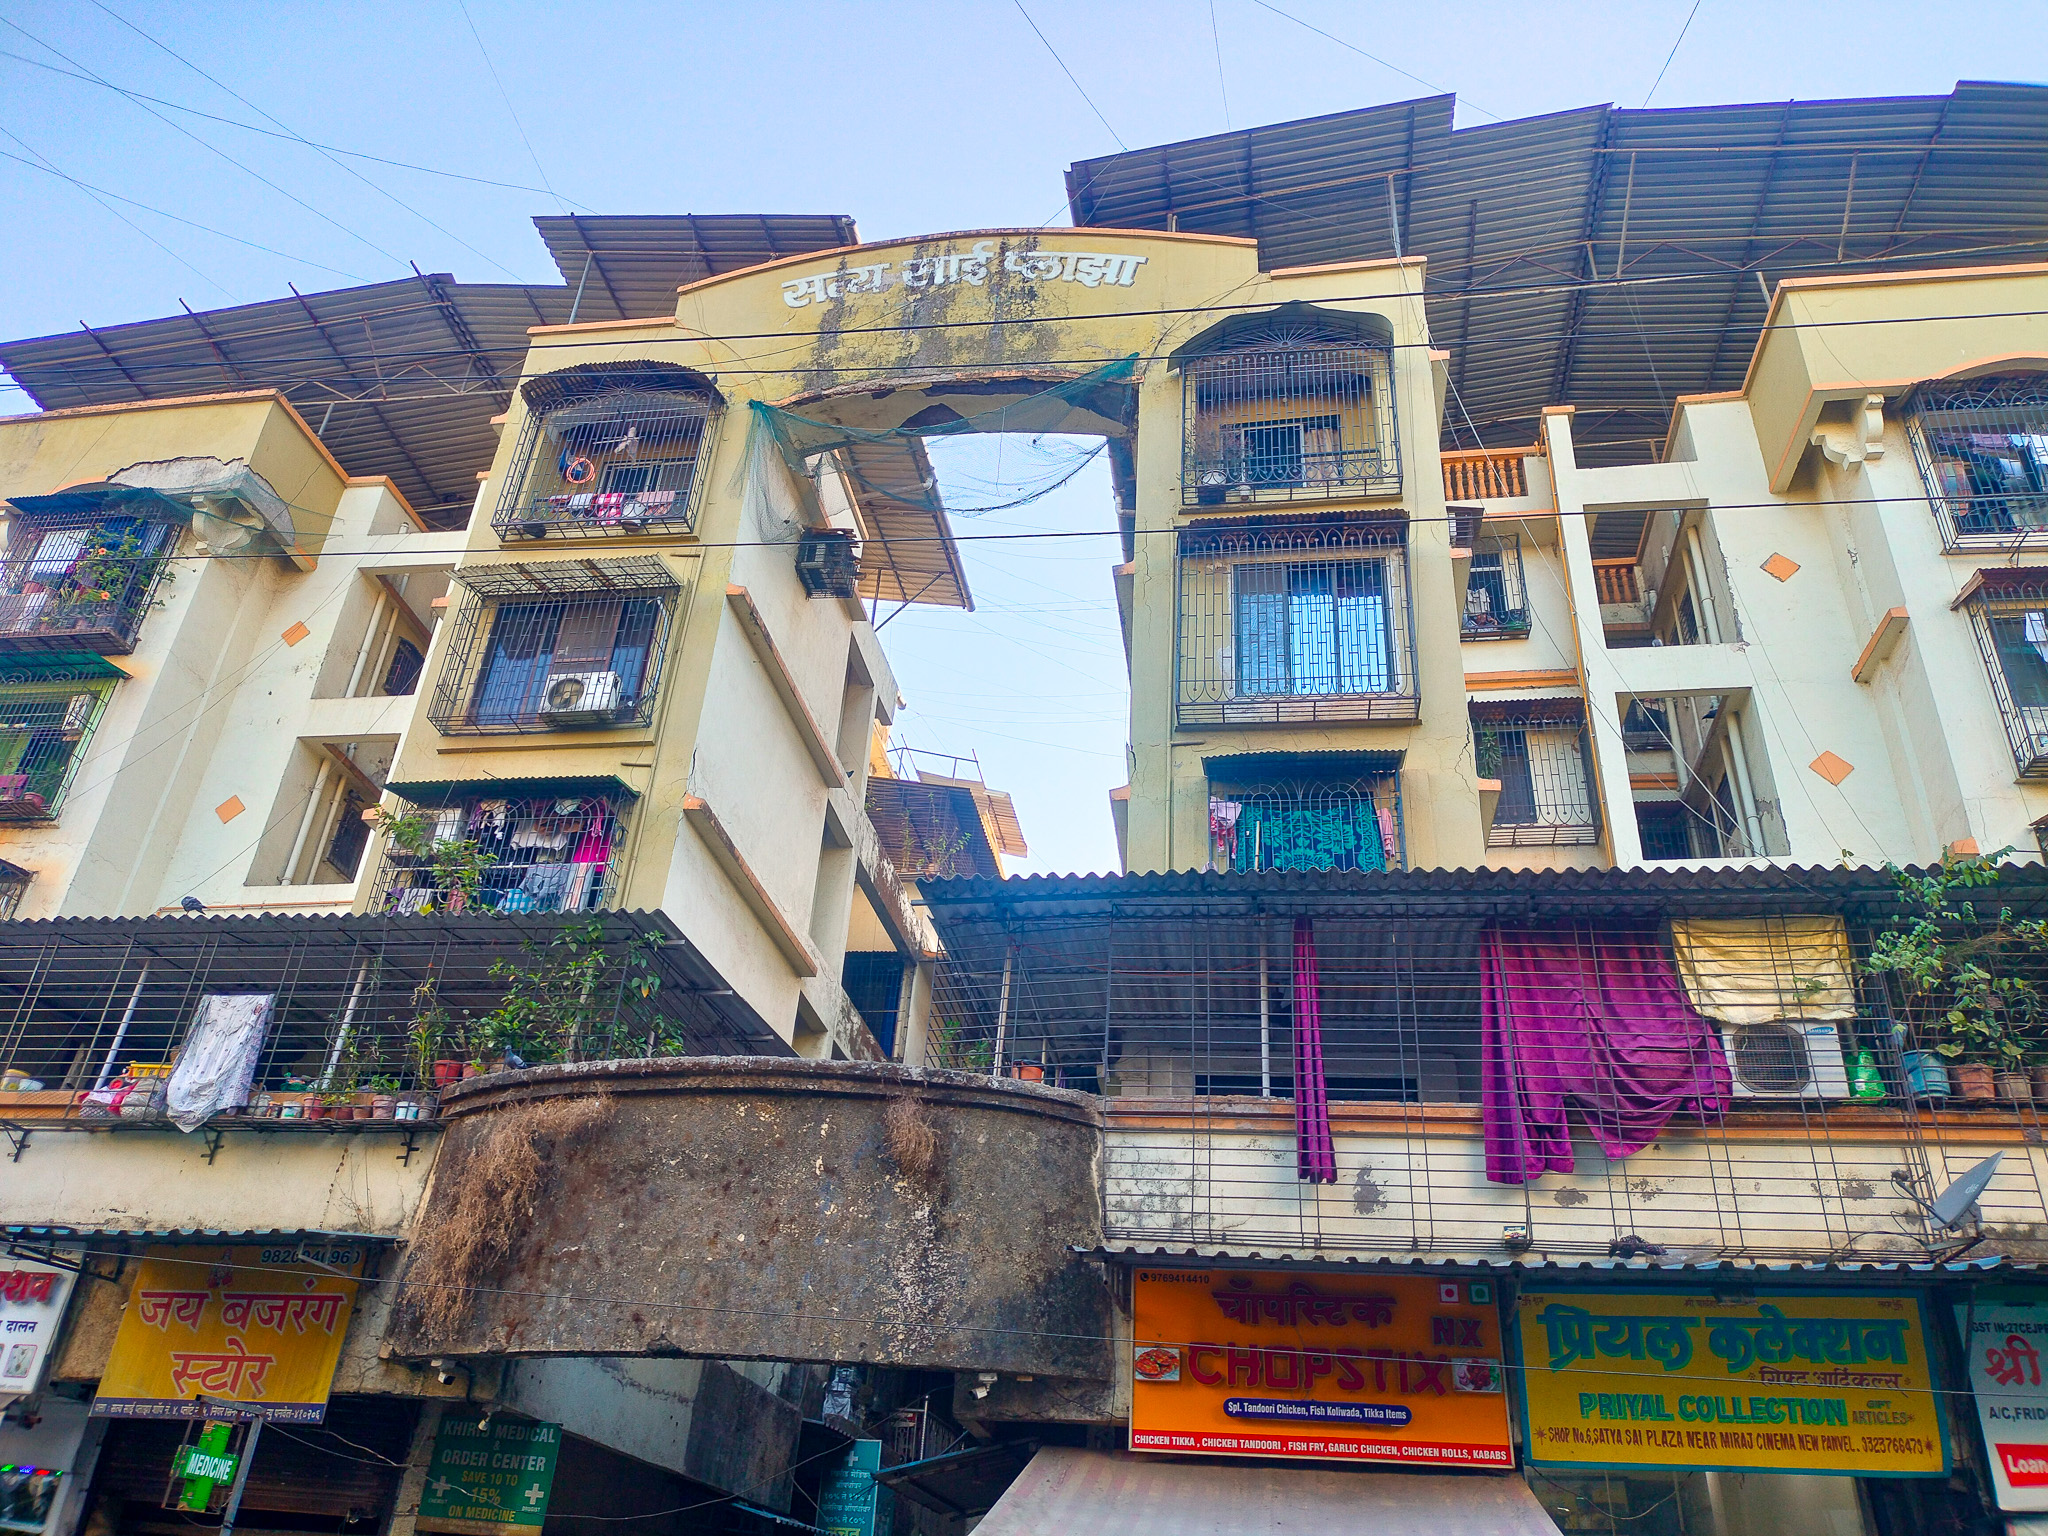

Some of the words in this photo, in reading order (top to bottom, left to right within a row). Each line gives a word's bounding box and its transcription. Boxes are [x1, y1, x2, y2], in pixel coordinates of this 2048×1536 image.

[781, 263, 892, 309] सत्य
[902, 241, 994, 287] साई
[1004, 250, 1150, 288] प्लाझा
[1150, 1272, 1210, 1285] 9769414410
[139, 1290, 211, 1334] जय
[221, 1277, 347, 1335] बजरंग
[1211, 1278, 1398, 1328] चॉपस्टिक
[6, 1320, 38, 1333] दालन
[1431, 1316, 1484, 1348] NX
[1973, 1322, 1991, 1333] GST
[1537, 1303, 1700, 1372] प्रियल
[1706, 1305, 1910, 1373] कलेक्शन
[170, 1337, 277, 1397] स्टोर
[1187, 1342, 1453, 1397] CHOPSTIX
[1984, 1334, 2041, 1386] श्री
[1759, 1366, 1810, 1387] गिफ्ट
[1228, 1402, 1242, 1412] Spl.
[1243, 1403, 1275, 1414] Tandoori
[1276, 1404, 1308, 1416] Chicken,
[1310, 1405, 1325, 1416] Fish
[1326, 1406, 1362, 1419] Koliwada,
[1364, 1408, 1384, 1418] Tikka
[1385, 1408, 1407, 1419] Items
[1579, 1392, 1675, 1421] PRIYAL
[1678, 1393, 1848, 1426] COLLECTION
[1852, 1410, 1908, 1425] ARTICLES
[1990, 1406, 2048, 1422] A/C,FRID
[495, 1423, 555, 1443] MEDICAL
[1549, 1427, 1570, 1443] SHOP
[1594, 1428, 1623, 1446] SATYA
[1626, 1428, 1643, 1446] SAI
[1646, 1429, 1684, 1448] PLAZA
[1685, 1430, 1718, 1449] NEAR
[1720, 1431, 1753, 1450] MIRAJ
[1756, 1432, 1796, 1450] CINEMA
[1797, 1433, 1819, 1451] NEW
[493, 1440, 501, 1450] &
[1134, 1434, 1170, 1445] CHICKEN
[1172, 1436, 1195, 1446] TIKKA
[1202, 1438, 1238, 1448] CHICKEN
[1240, 1439, 1281, 1450] TANDOORI
[1288, 1441, 1307, 1451] FISH
[1328, 1443, 1359, 1453] GARLIC
[1360, 1444, 1400, 1456] CHICKEN,
[1402, 1446, 1439, 1457] CHICKEN
[1441, 1448, 1471, 1460] ROLLS,
[1473, 1450, 1507, 1460] KABABS
[186, 1453, 233, 1480] MEDICINE
[442, 1449, 488, 1467] ORDER
[492, 1452, 546, 1471] CENTER
[461, 1470, 487, 1484] SAVE
[490, 1473, 503, 1485] 10
[506, 1474, 518, 1486] TO
[471, 1486, 501, 1505] 15%
[448, 1505, 462, 1518] ON
[466, 1506, 516, 1521] MEDICINE
